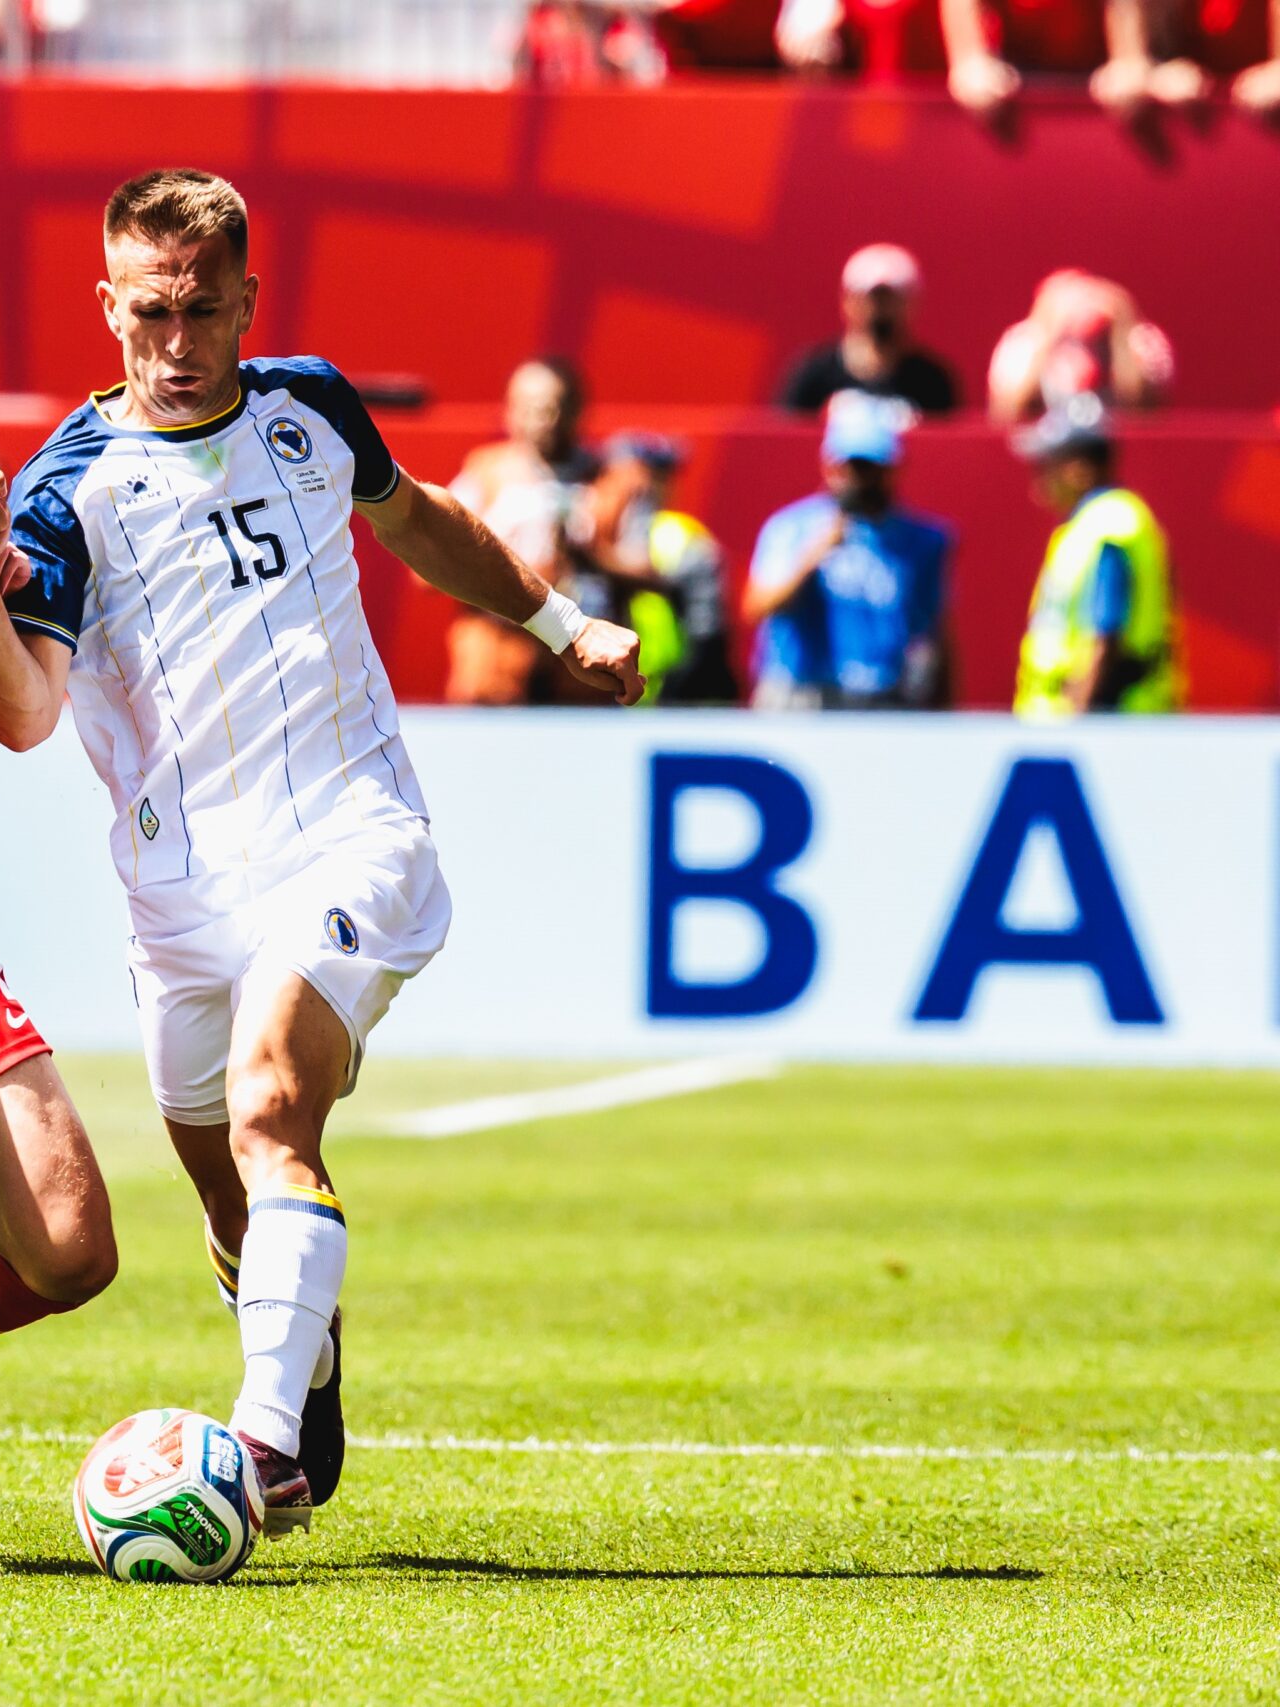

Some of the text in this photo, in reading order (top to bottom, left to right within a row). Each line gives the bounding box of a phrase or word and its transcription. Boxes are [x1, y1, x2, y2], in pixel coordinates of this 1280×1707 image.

[207, 498, 291, 592] 15
[647, 752, 1280, 1025] BA
[185, 1500, 223, 1546] TRIONDA
